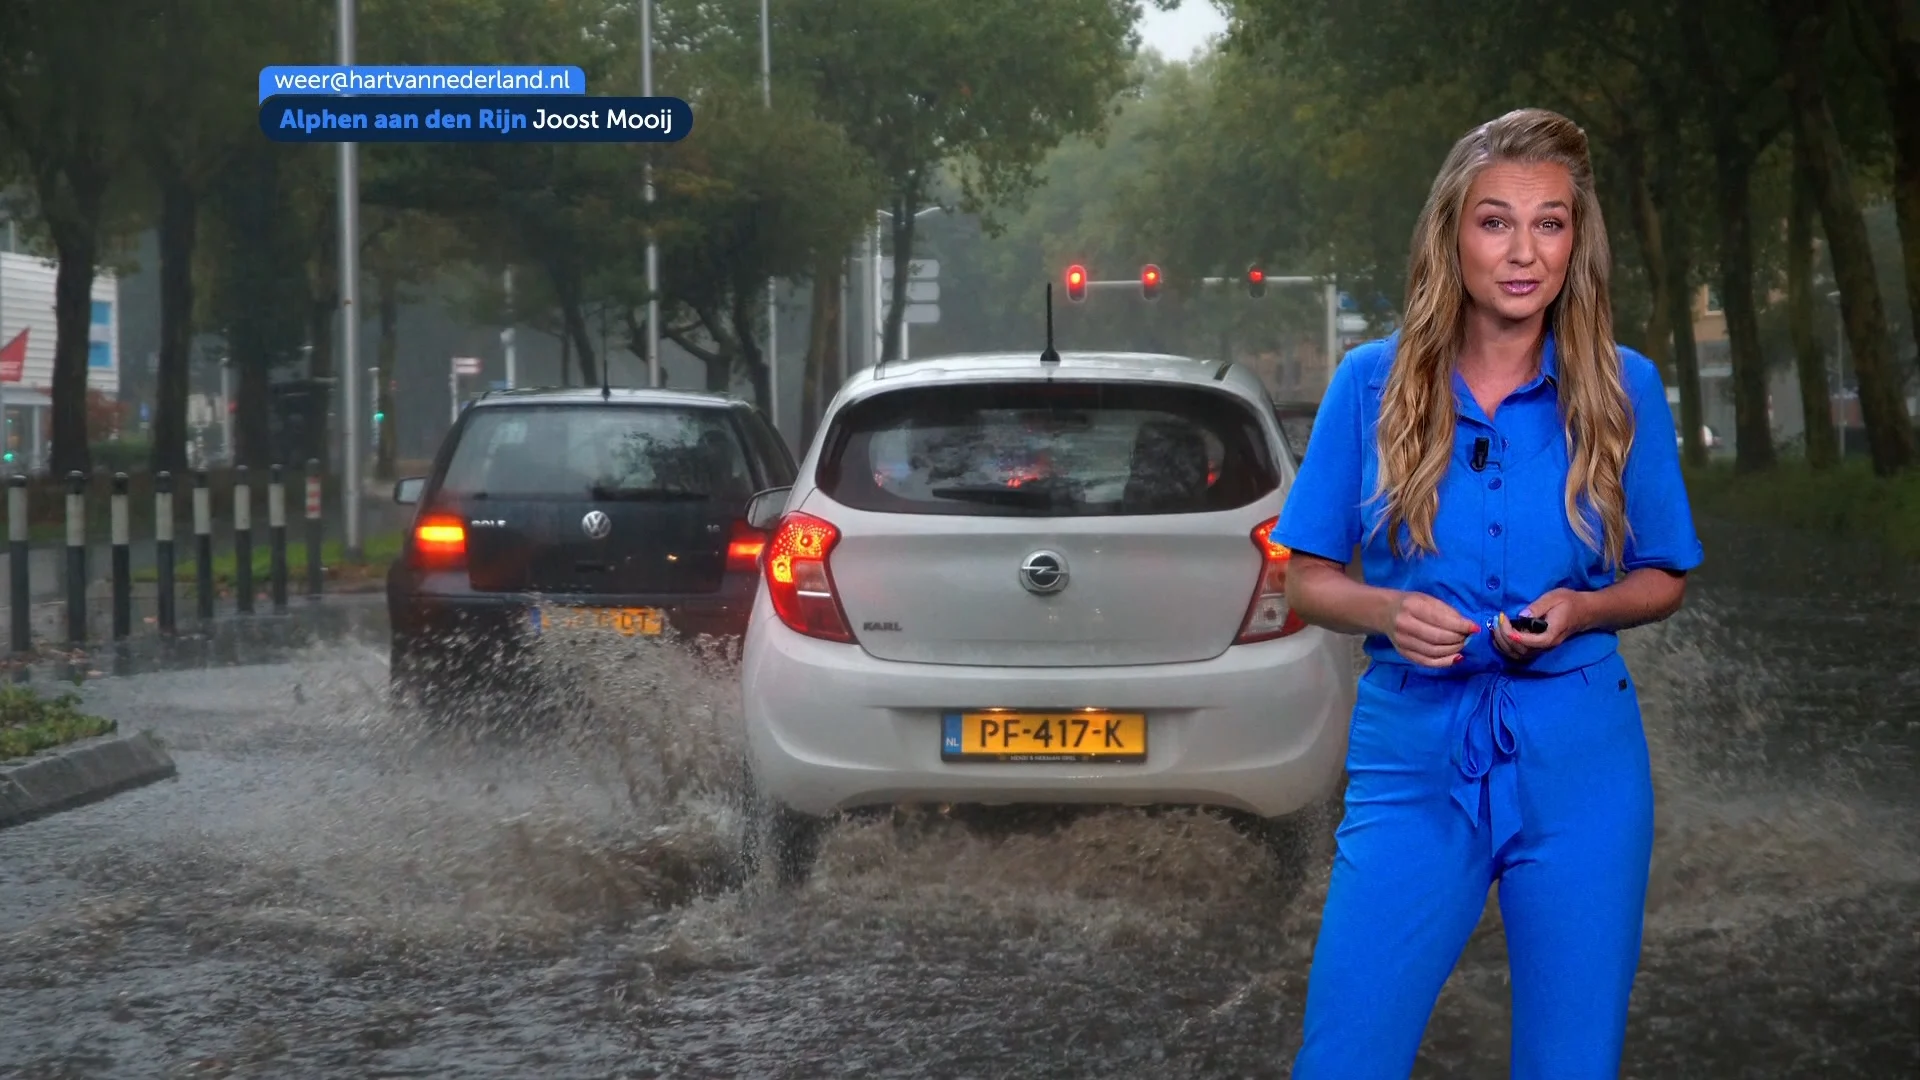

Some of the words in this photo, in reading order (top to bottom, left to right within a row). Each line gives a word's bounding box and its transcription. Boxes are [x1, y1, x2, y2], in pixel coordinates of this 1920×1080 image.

[863, 621, 903, 632] KARL
[979, 718, 1125, 749] PF-417-K
[945, 737, 960, 748] NL
